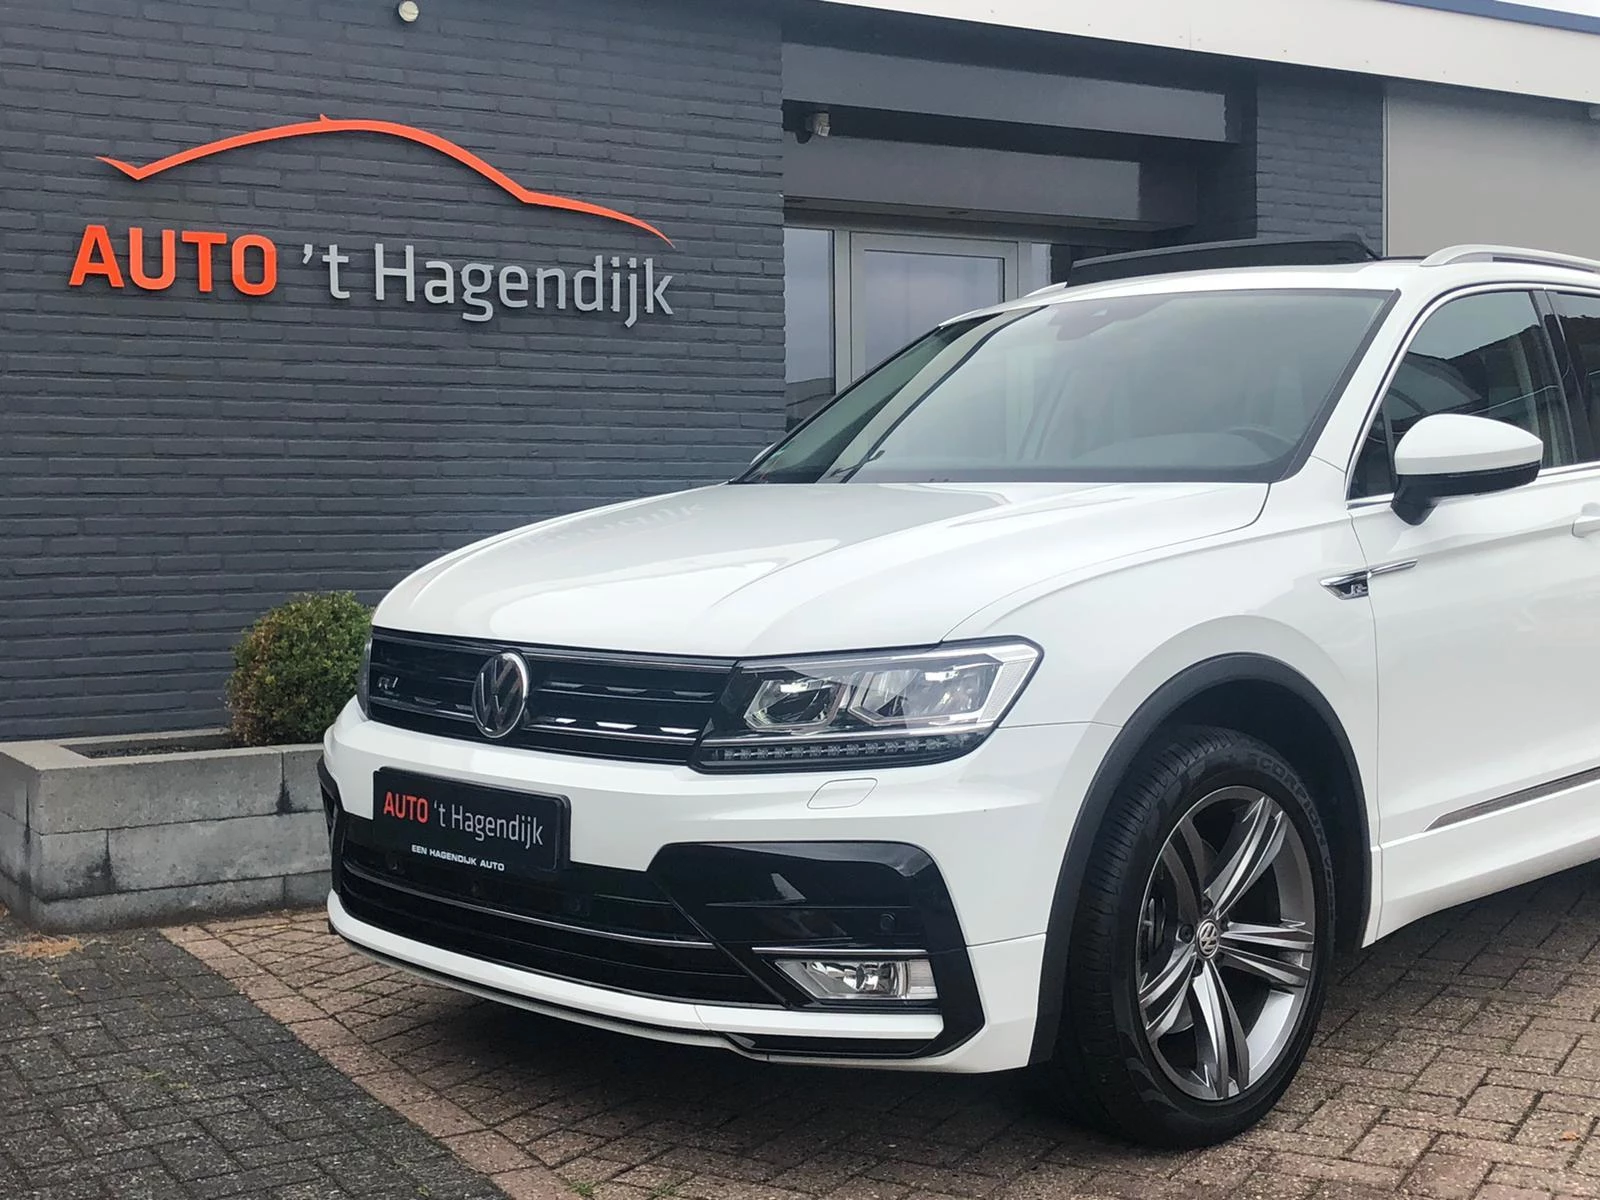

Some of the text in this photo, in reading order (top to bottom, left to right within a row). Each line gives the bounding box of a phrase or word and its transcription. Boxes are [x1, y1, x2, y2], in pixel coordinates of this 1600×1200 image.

[69, 224, 675, 328] AUTO 't Hagendijk
[383, 791, 429, 825] AUTO
[451, 804, 544, 850] Hagendijk
[411, 844, 505, 872] EEN HAGENDIJK AUTO
